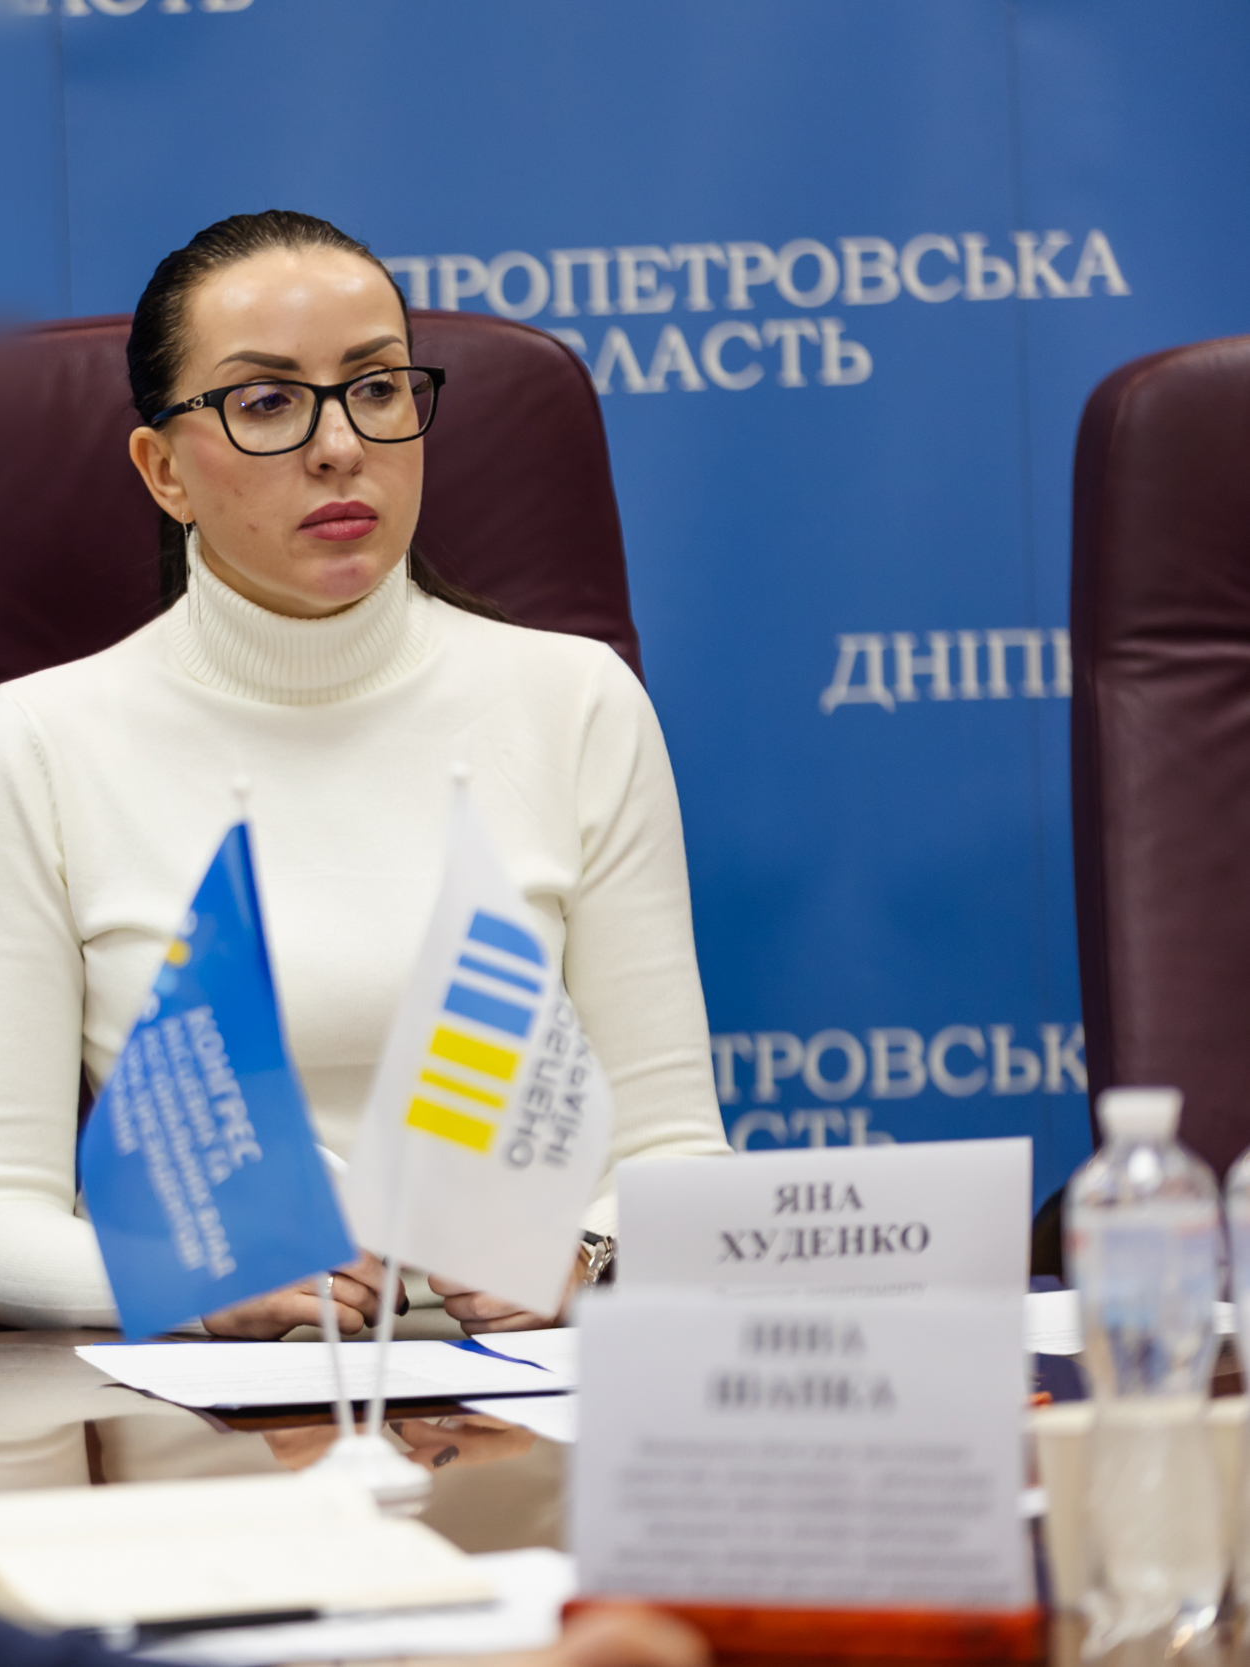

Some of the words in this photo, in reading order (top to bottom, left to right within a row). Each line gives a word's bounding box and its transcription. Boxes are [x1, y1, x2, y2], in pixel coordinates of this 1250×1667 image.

[548, 315, 874, 396] ЛАСТЬ
[184, 1004, 263, 1170] КОНГРЕС
[772, 1181, 865, 1217] ЯНА
[718, 1221, 932, 1266] ХУДЕНКО
